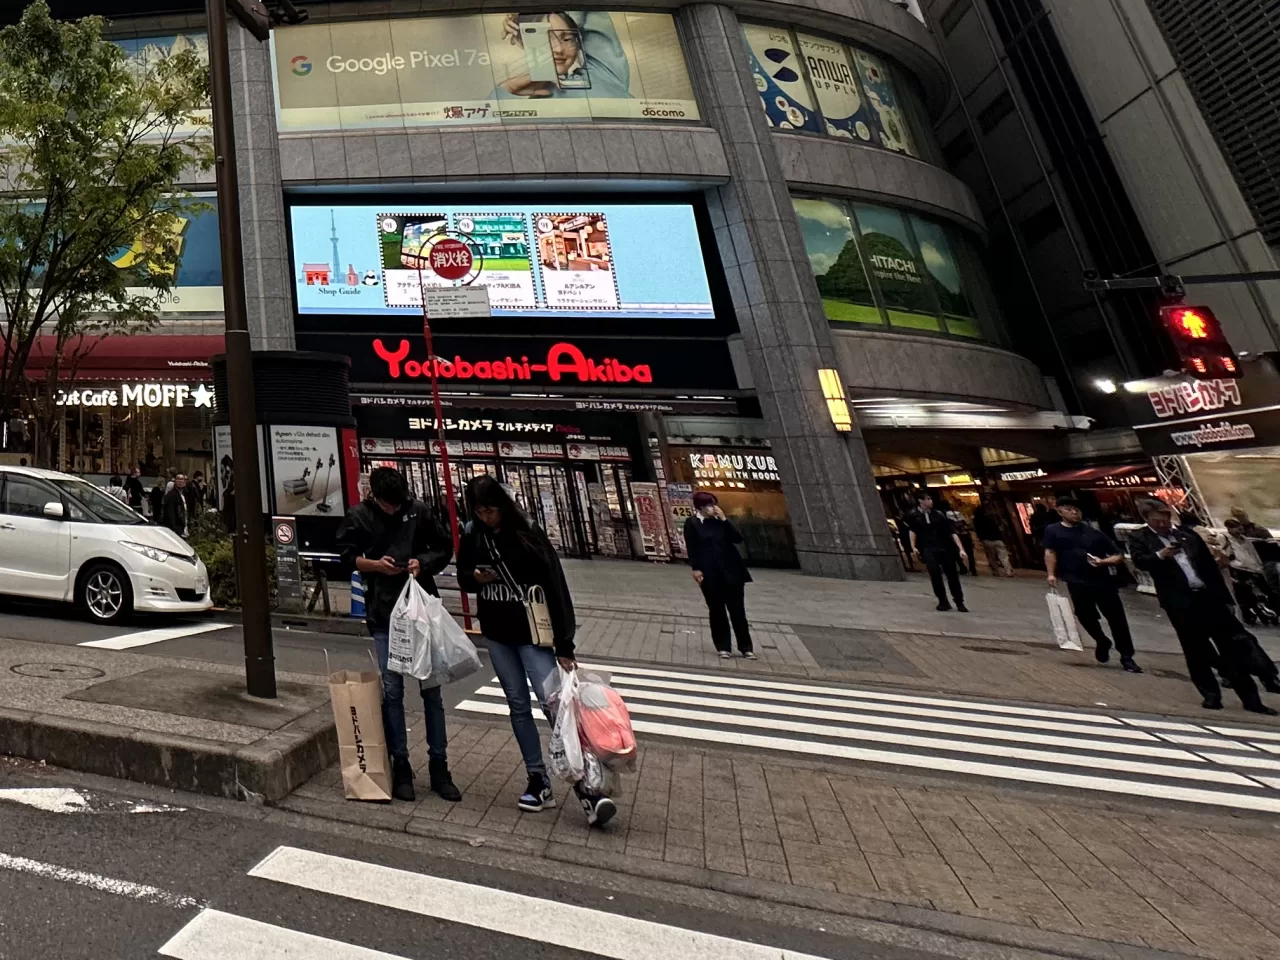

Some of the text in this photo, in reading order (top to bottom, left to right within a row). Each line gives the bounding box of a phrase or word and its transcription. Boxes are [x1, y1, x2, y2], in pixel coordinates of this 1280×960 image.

[326, 51, 406, 77] Google
[410, 47, 461, 69] Pixel
[463, 48, 491, 68] 7a
[444, 106, 488, 119] 爆アゲ
[642, 107, 685, 117] docomo
[433, 251, 469, 268] 消火栓
[318, 287, 361, 298] Shop Guide
[373, 339, 652, 383] Yodobashi-Akiba
[81, 384, 189, 407] Café MOFF
[360, 397, 405, 405] ヨドバシカメラ
[1147, 379, 1241, 418] ヨドバシカメラ
[575, 402, 622, 410] ヨドバシカメラ
[408, 418, 493, 431] ヨドバシカメラ
[496, 423, 553, 432] マルチメディア
[1171, 422, 1255, 448] www.yodobashi.com
[690, 453, 777, 471] KAMUKUR
[694, 470, 780, 481] SOUP WITH NOODL
[672, 507, 692, 517] 425
[349, 705, 367, 773] ヨドバシカメラ
